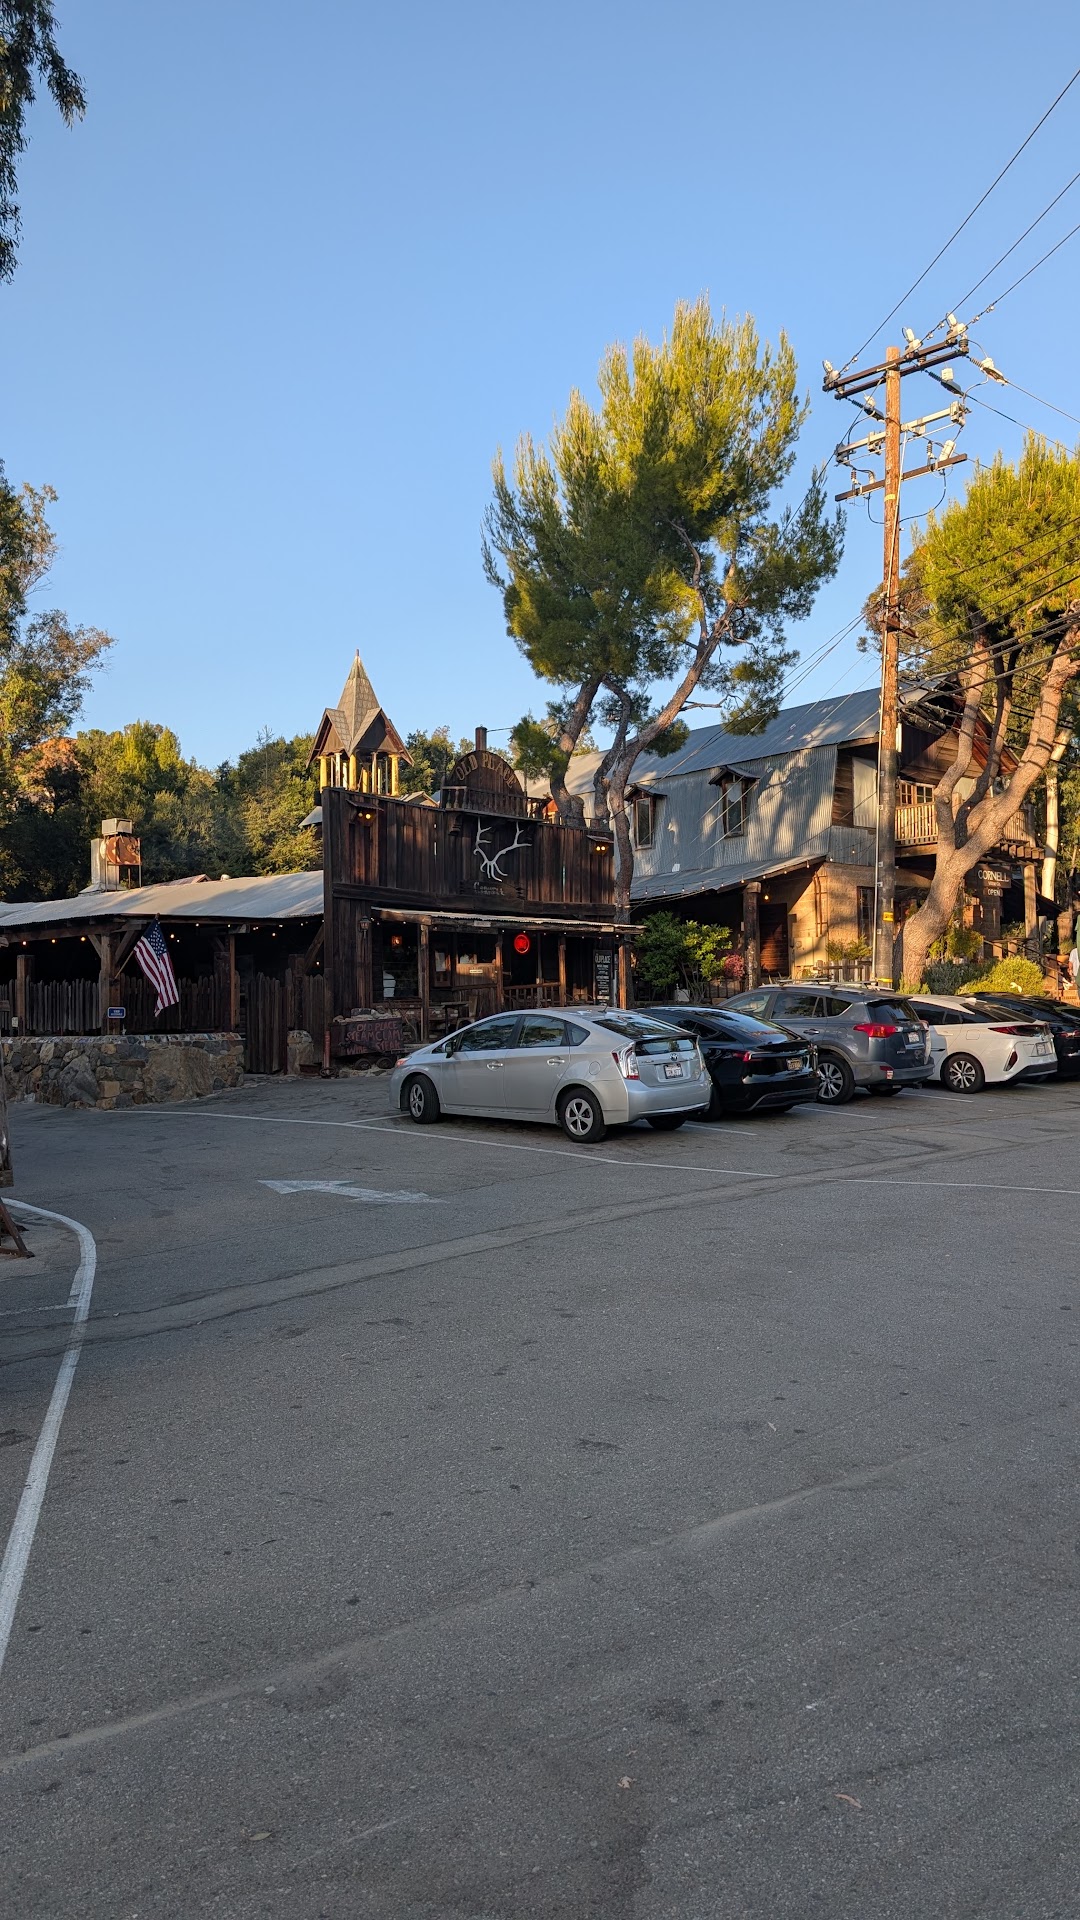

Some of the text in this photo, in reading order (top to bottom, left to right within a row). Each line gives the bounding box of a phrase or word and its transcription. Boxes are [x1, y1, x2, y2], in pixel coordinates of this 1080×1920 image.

[455, 752, 517, 789] OLD PLACE
[978, 870, 1010, 882] CORNELL
[987, 888, 1001, 897] OPEN
[356, 1021, 398, 1032] OLD PLACE
